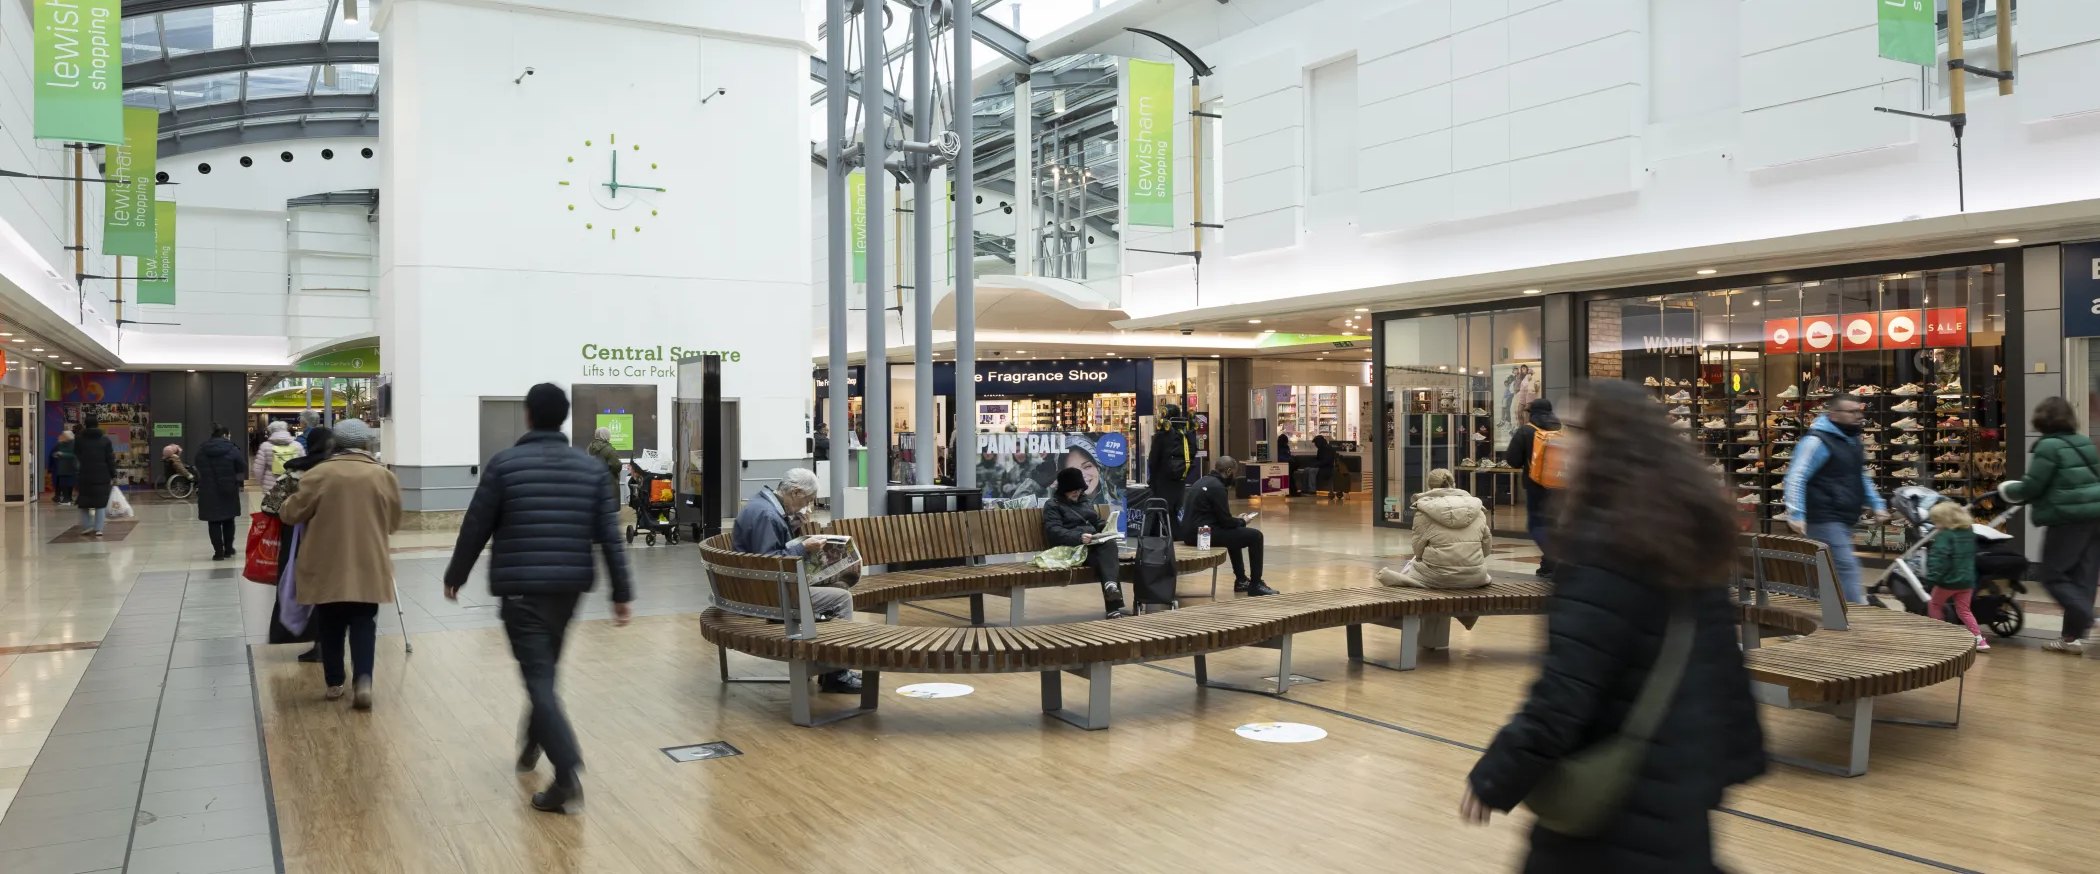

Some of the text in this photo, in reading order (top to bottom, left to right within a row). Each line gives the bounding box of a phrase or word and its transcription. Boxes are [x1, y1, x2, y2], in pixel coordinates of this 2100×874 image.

[88, 7, 110, 91] shopping
[1135, 95, 1153, 197] lewisham
[1156, 140, 1168, 198] shopping
[134, 176, 149, 227] shopping
[160, 245, 171, 283] shopping
[1927, 322, 1963, 332] SALE
[581, 343, 663, 361] Central
[583, 364, 676, 378] Lifts to Car Park
[988, 371, 1064, 384] Fragrance
[1068, 370, 1108, 382] Shop
[976, 434, 1070, 454] PAINTBALL
